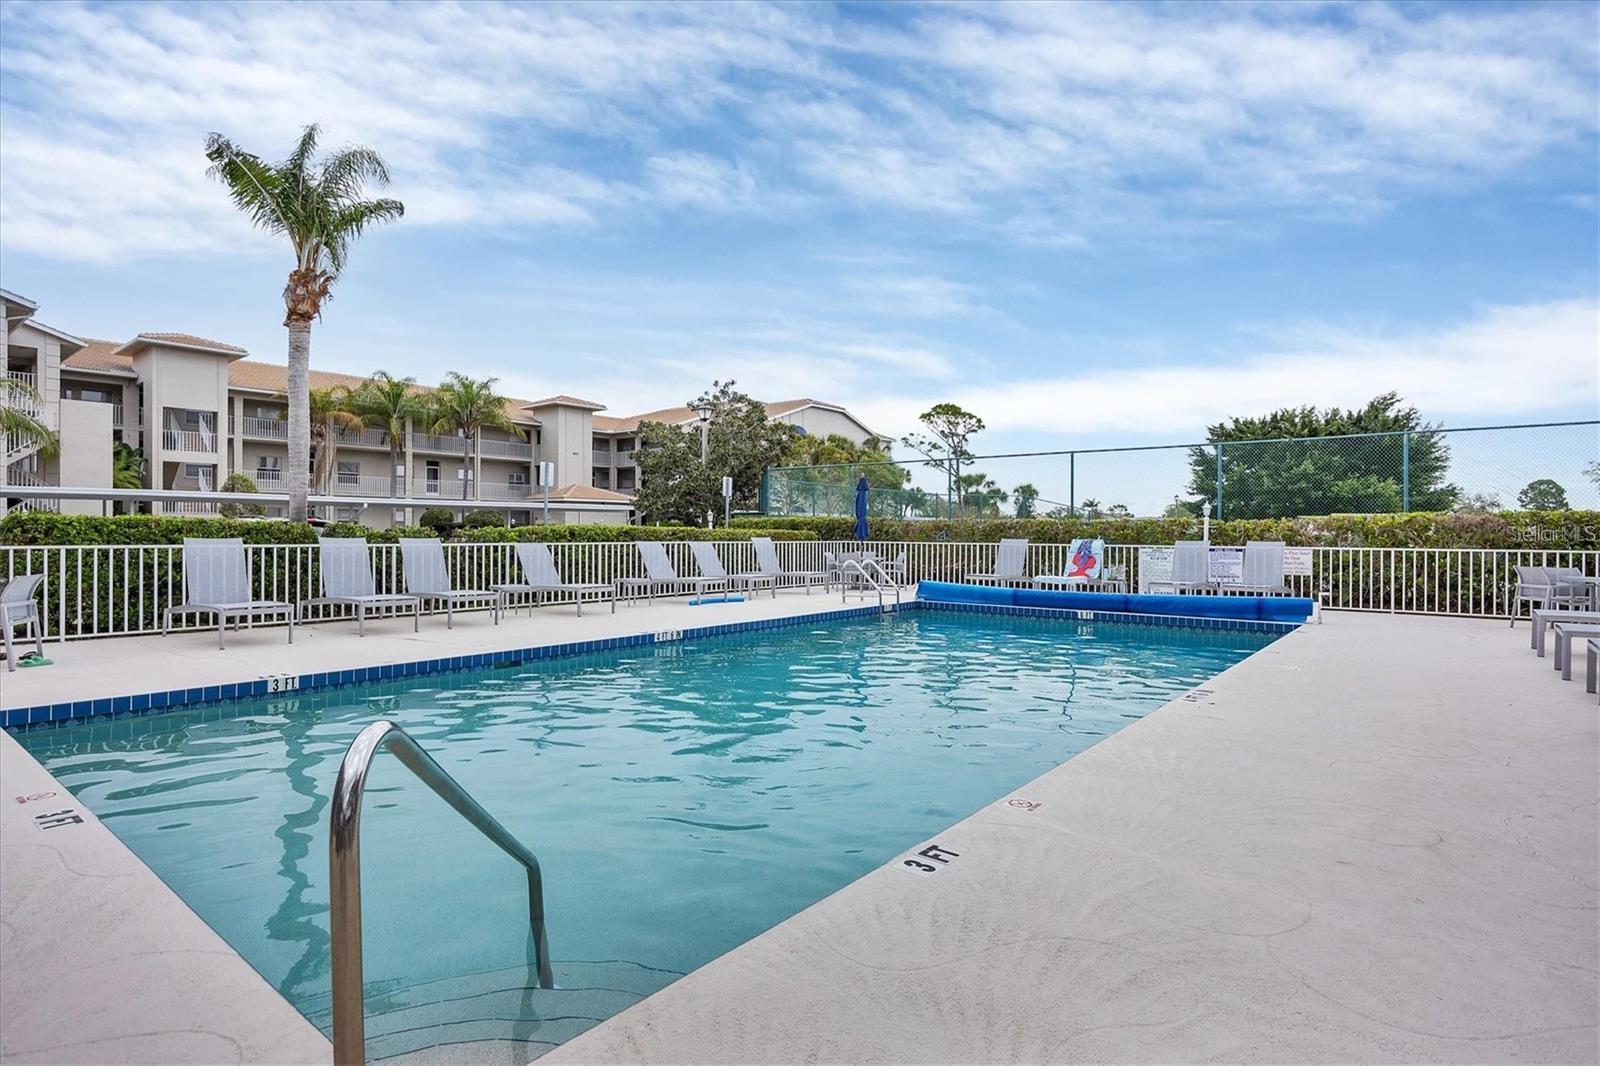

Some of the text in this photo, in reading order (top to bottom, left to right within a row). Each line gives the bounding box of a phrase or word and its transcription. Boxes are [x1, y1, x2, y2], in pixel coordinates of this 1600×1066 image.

[272, 678, 280, 692] 3
[35, 809, 85, 830] 3 FT
[903, 844, 960, 873] 3 FT
